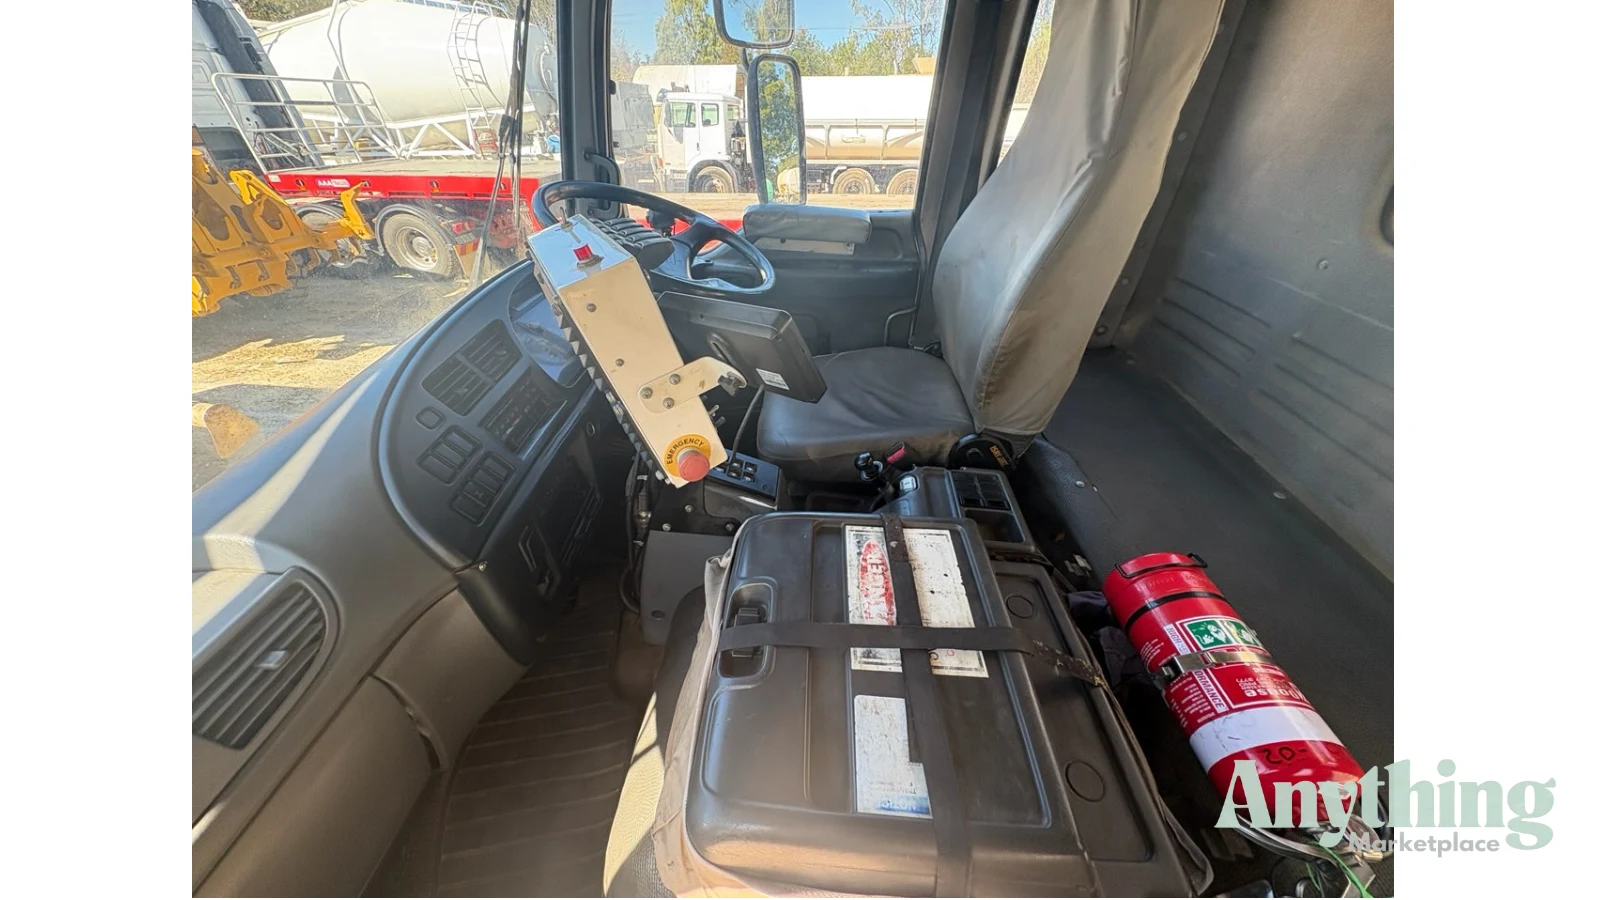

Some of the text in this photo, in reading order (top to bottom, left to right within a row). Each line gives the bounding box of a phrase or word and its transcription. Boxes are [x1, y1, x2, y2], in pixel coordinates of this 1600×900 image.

[667, 438, 704, 465] EMERGENCY
[866, 550, 887, 624] ANGER
[1195, 671, 1225, 709] ORMANCE
